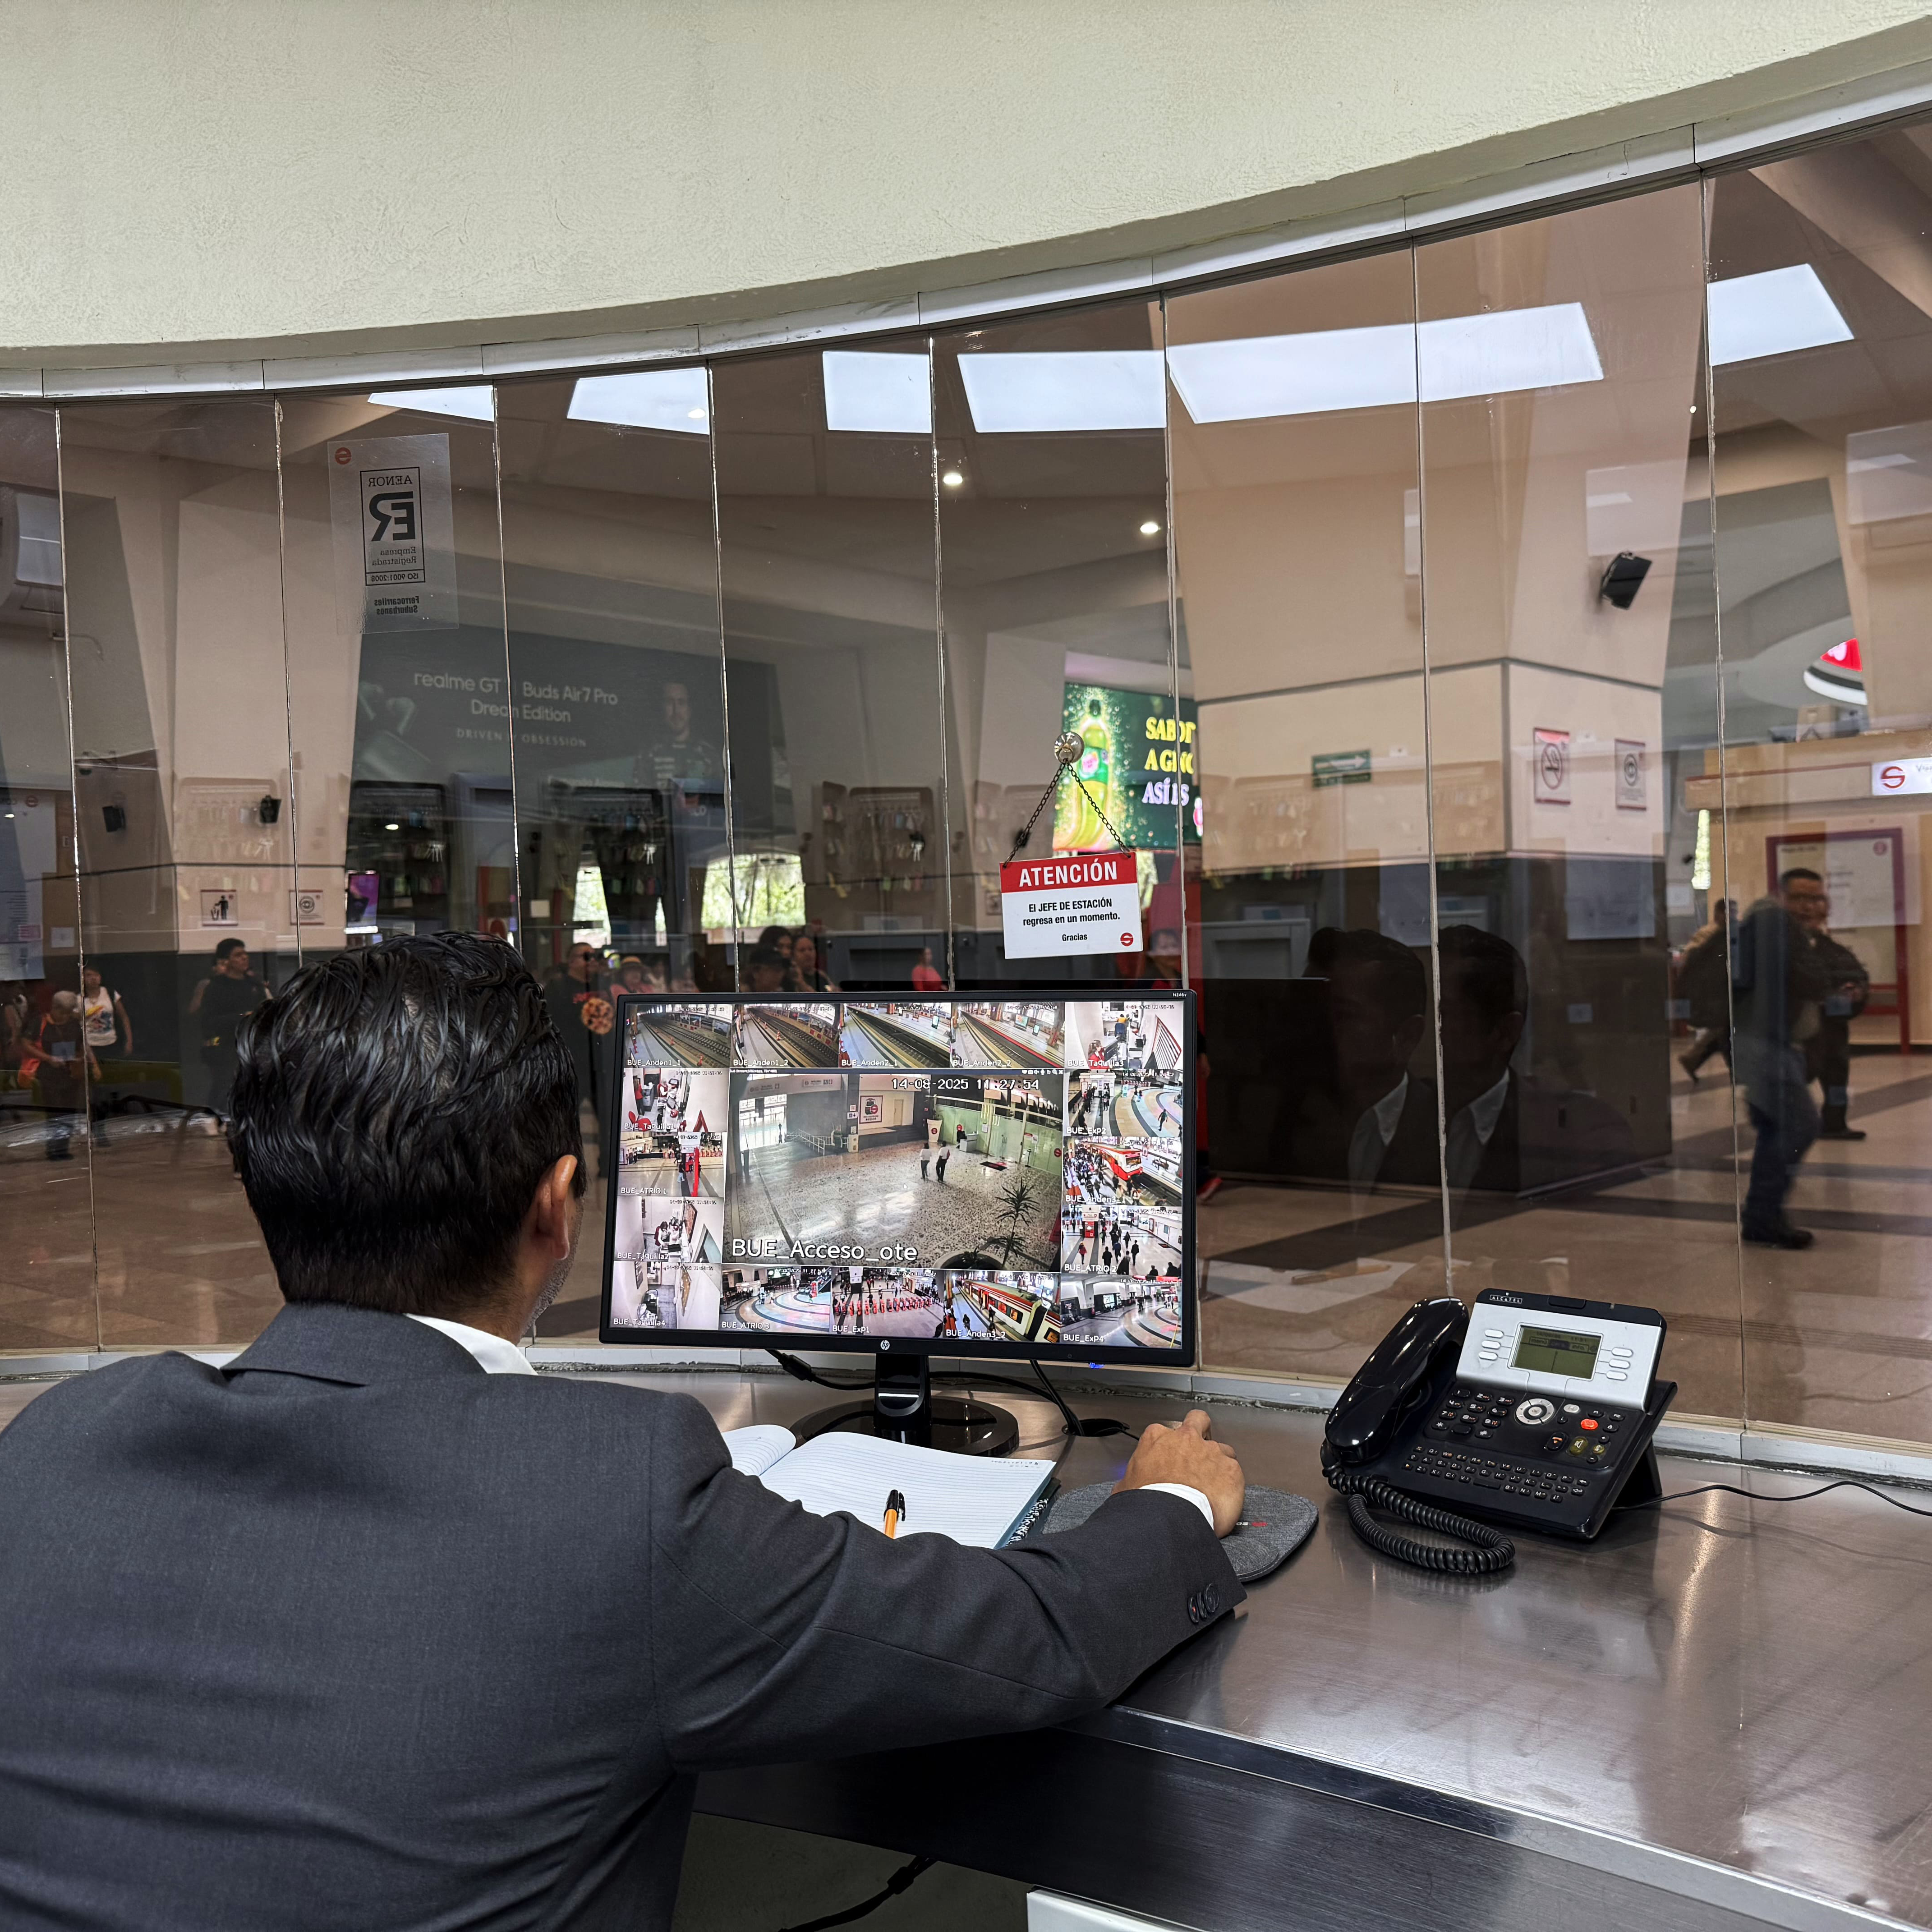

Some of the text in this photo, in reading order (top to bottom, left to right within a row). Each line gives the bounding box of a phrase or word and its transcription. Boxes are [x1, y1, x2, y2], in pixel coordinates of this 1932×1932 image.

[414, 673, 475, 691] realme
[480, 678, 501, 693] GT
[523, 682, 559, 700] Buds
[594, 689, 618, 705] Pro
[523, 704, 571, 722] Edition
[456, 727, 502, 741] DRIVEN
[522, 733, 586, 747] OBSESSION
[1019, 858, 1117, 887] ATENCIÓN
[1038, 902, 1057, 912] JEFE
[1060, 902, 1070, 911] DE
[1072, 897, 1112, 910] ESTACIÓN
[1023, 916, 1053, 927] regresa
[1080, 912, 1120, 922] momento.
[1062, 933, 1088, 942] Gracias
[892, 1079, 1040, 1090] 14-08-2025 11:27:54
[732, 1238, 918, 1261] BUE_Acceso_ote
[1064, 1264, 1109, 1272] BUE_ATRIO
[722, 1321, 764, 1329] BUE_ATRIO
[946, 1329, 1006, 1339] BUE_Anden3_2
[881, 1340, 890, 1350] hp
